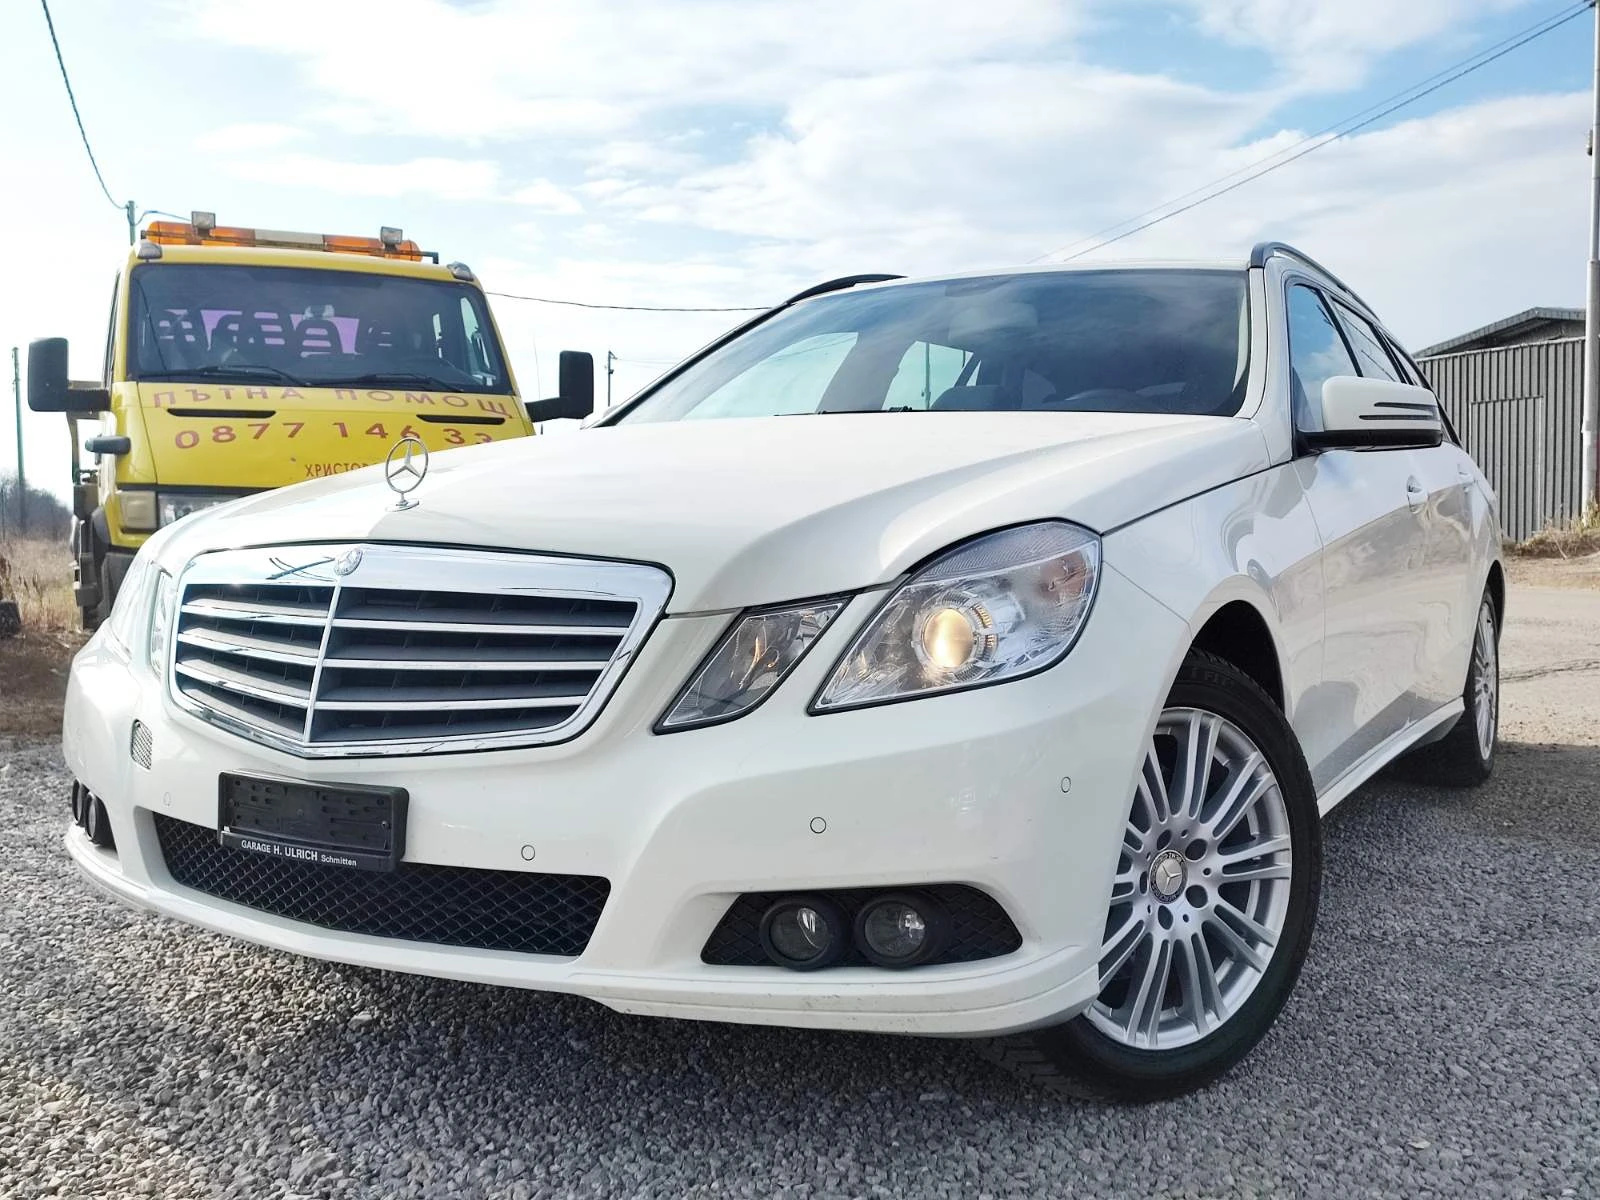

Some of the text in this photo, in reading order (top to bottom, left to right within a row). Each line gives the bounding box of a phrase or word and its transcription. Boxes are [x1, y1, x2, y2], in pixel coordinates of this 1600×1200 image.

[153, 387, 513, 419] ПЪТНА ПОМОЩ
[175, 422, 305, 449] 0877
[333, 422, 420, 440] 146
[241, 840, 357, 867] GARAGE H. ULRICH Schmitten
